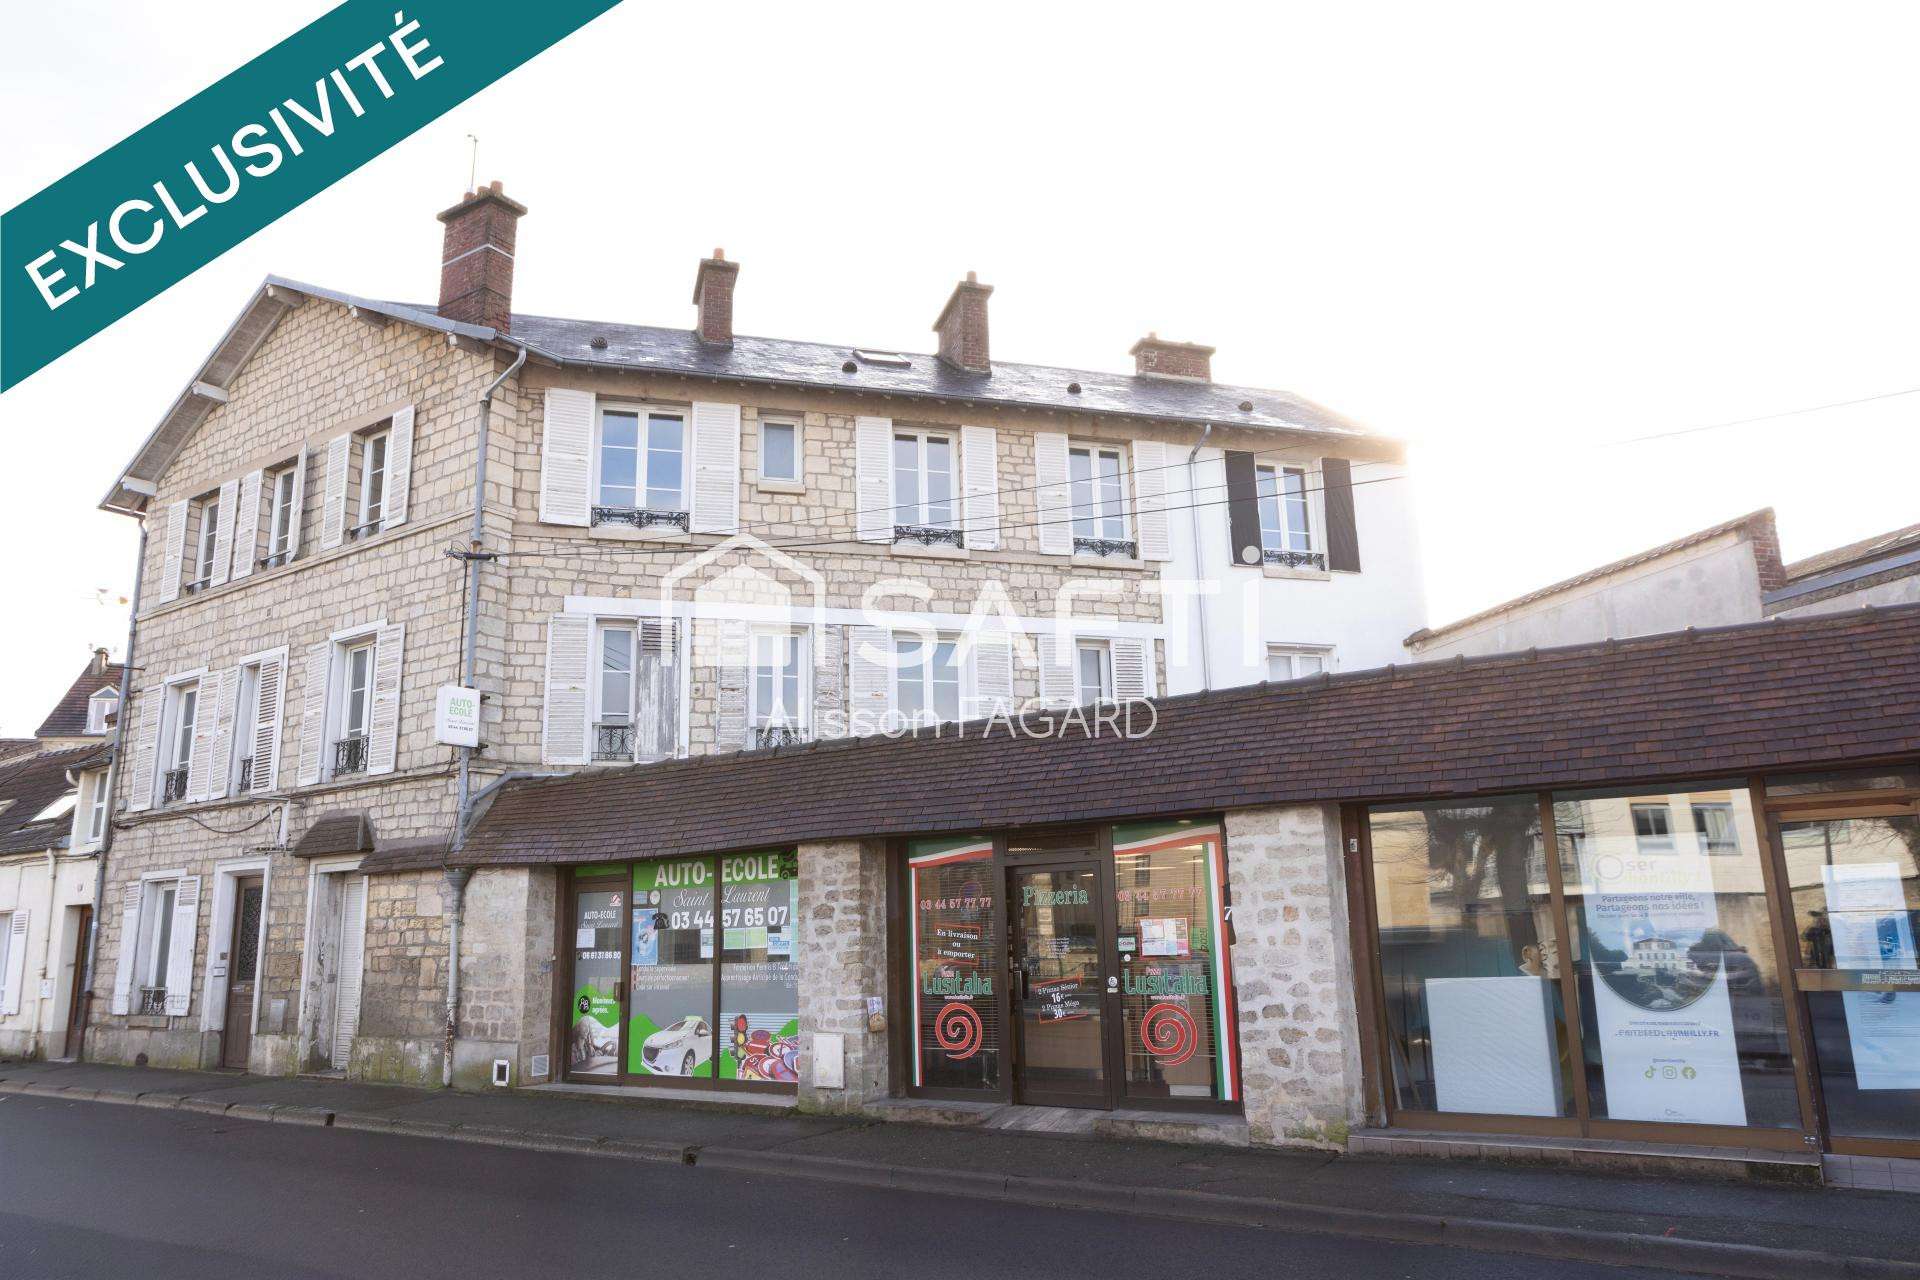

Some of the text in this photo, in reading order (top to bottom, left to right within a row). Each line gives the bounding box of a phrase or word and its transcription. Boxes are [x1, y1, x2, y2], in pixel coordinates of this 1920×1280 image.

[448, 706, 473, 718] ECOLE
[655, 855, 779, 886] AUTO- ECOLE
[673, 884, 771, 907] Saint Laurent
[1023, 884, 1089, 907] Pizzeria
[1601, 895, 1649, 904] Partageons
[1650, 893, 1673, 901] notre
[920, 897, 992, 911] 03 44 57 77 77
[1596, 903, 1649, 913] Partageons
[671, 906, 788, 930] 03 44 57 65 07
[1224, 906, 1232, 921] 7
[936, 928, 978, 940] En livraison
[943, 950, 976, 959] emporter
[922, 970, 994, 995] Lusitalia
[1123, 968, 1209, 995] Lusitalia
